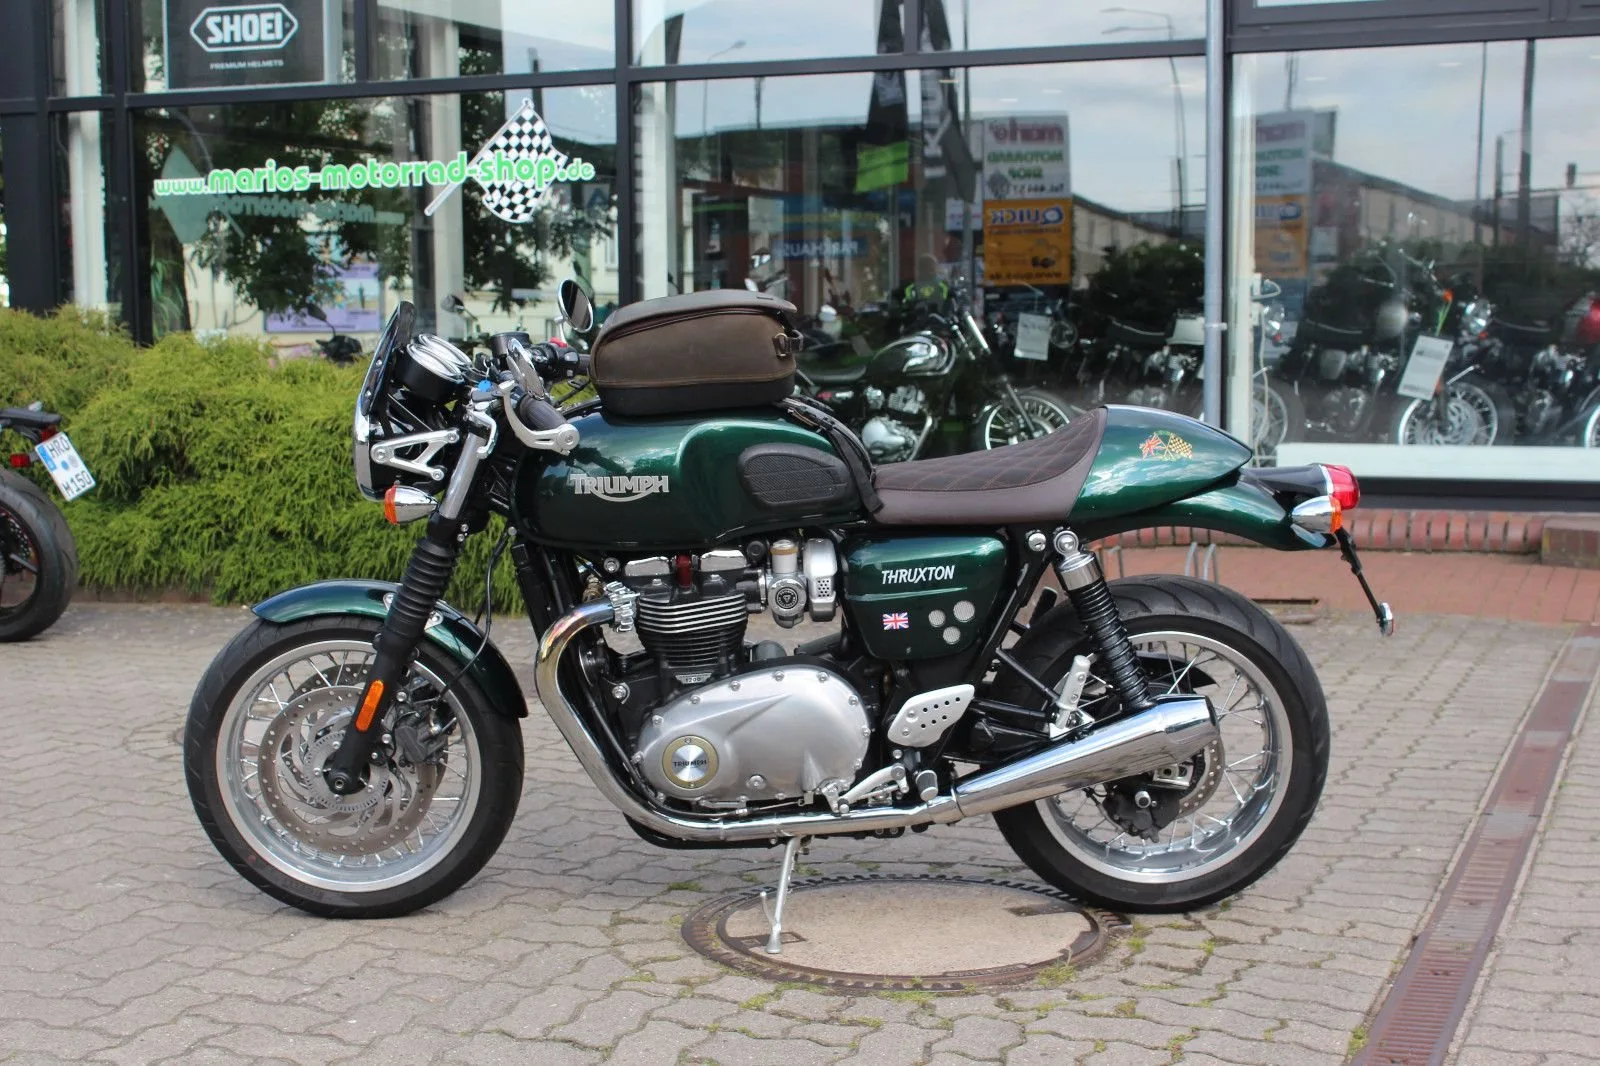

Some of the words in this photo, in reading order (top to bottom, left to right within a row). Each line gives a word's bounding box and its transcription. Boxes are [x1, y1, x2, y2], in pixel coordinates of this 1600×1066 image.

[205, 11, 284, 44] SHOEI
[209, 61, 246, 70] PREMIUM
[247, 59, 284, 68] HELMETS
[154, 150, 595, 196] www.marios-motorrad-shop.de
[46, 435, 71, 459] HRO
[569, 473, 669, 502] TRIUMPH
[881, 565, 956, 585] THRUXTON
[672, 759, 707, 768] TRIUMPH
